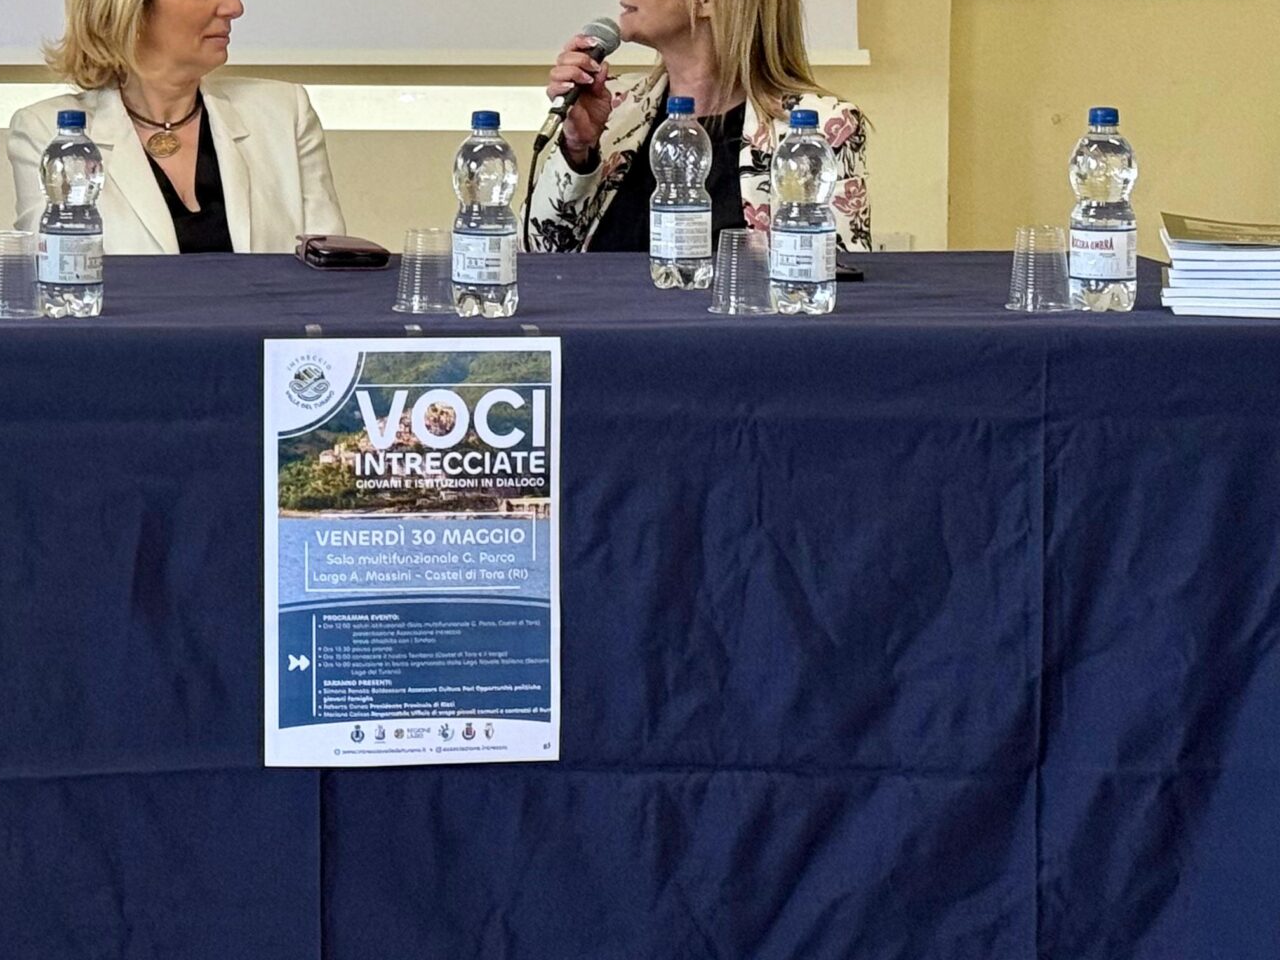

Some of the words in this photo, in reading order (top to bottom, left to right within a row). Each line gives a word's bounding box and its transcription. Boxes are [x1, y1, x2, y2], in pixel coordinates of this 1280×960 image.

[355, 388, 546, 450] VOCI
[355, 451, 546, 476] INTRECCIATE
[356, 478, 402, 489] GIOVANI
[404, 479, 411, 488] E
[414, 478, 478, 488] ISTITUZIONI
[482, 478, 493, 488] IN
[496, 477, 545, 488] DIALOGO
[315, 524, 405, 546] VENERDÌ
[411, 528, 436, 546] 30
[442, 528, 526, 545] MAGGIO
[358, 552, 459, 565] multifunzionale
[312, 571, 347, 584] Largo
[350, 571, 361, 582] A.
[366, 570, 412, 582] Massini
[424, 569, 462, 580] Castel
[465, 568, 477, 580] di
[480, 568, 505, 580] Tora
[508, 568, 528, 580] (RI)
